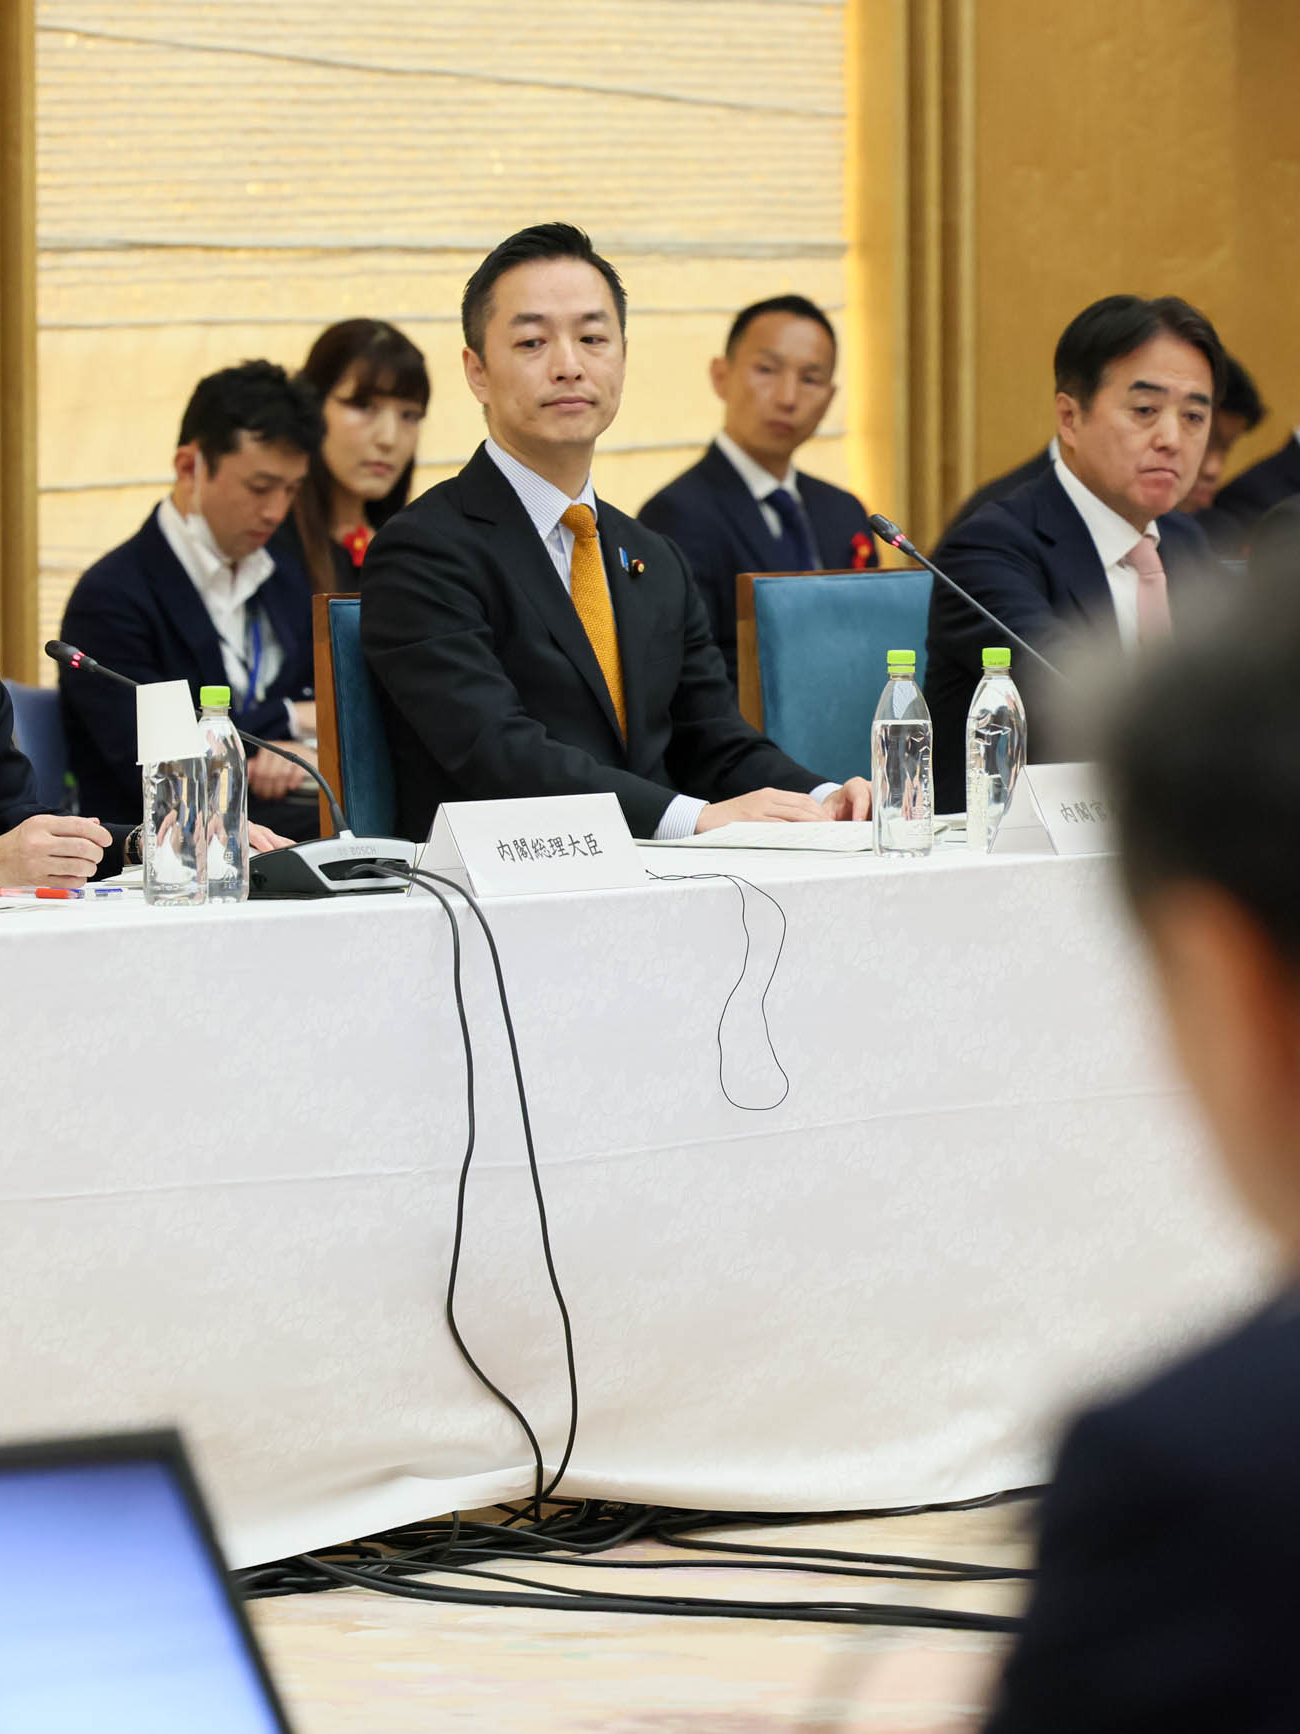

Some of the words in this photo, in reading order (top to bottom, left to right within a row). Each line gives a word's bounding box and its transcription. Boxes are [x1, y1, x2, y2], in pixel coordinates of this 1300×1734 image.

[349, 846, 377, 856] BOSCH
[496, 833, 603, 862] 内閣総理大臣
